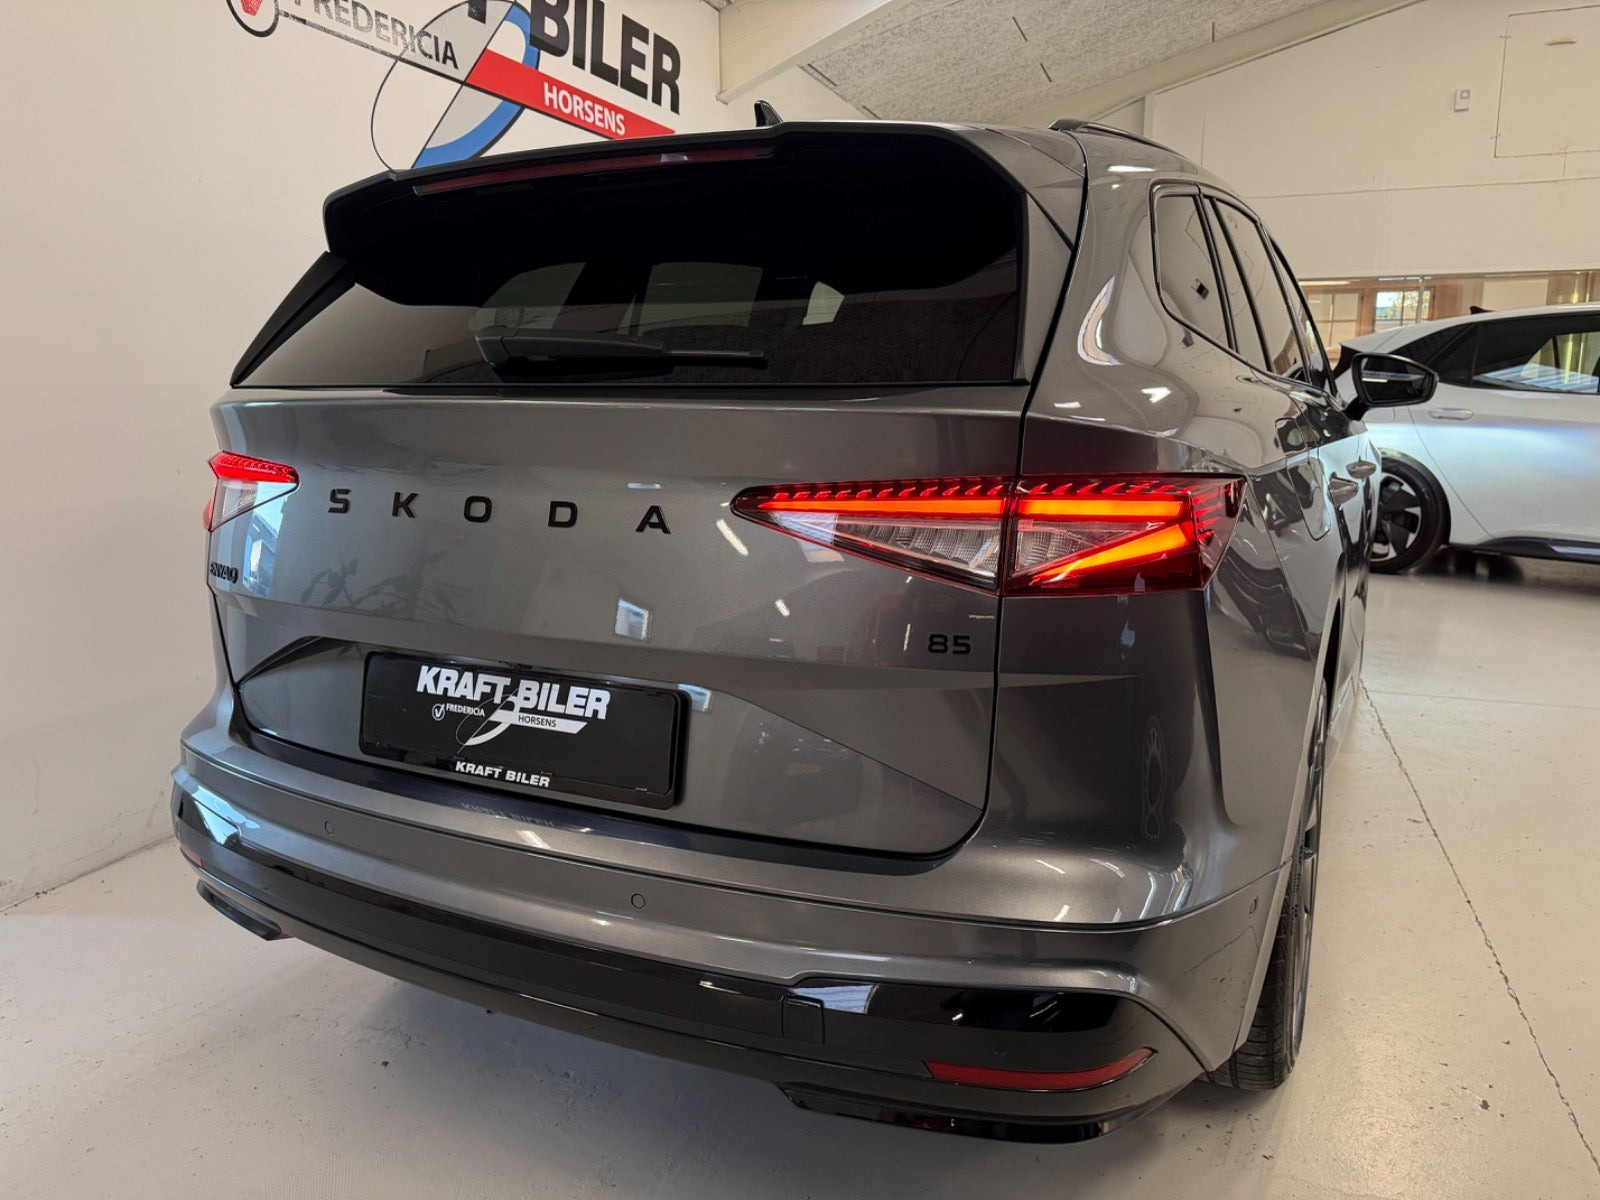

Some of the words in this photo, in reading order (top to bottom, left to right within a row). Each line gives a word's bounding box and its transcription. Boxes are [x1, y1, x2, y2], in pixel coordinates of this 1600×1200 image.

[294, 0, 459, 70] REDERICIA
[530, 0, 681, 115] BILER
[543, 82, 626, 136] HORSENS
[328, 487, 671, 534] SKODA
[928, 633, 971, 654] 85
[416, 665, 511, 704] KRAFT
[516, 680, 611, 719] BILER
[445, 703, 485, 717] FREDERICIA
[518, 715, 557, 728] HORSENS
[455, 761, 502, 779] KRAFT
[505, 770, 550, 788] BILER
